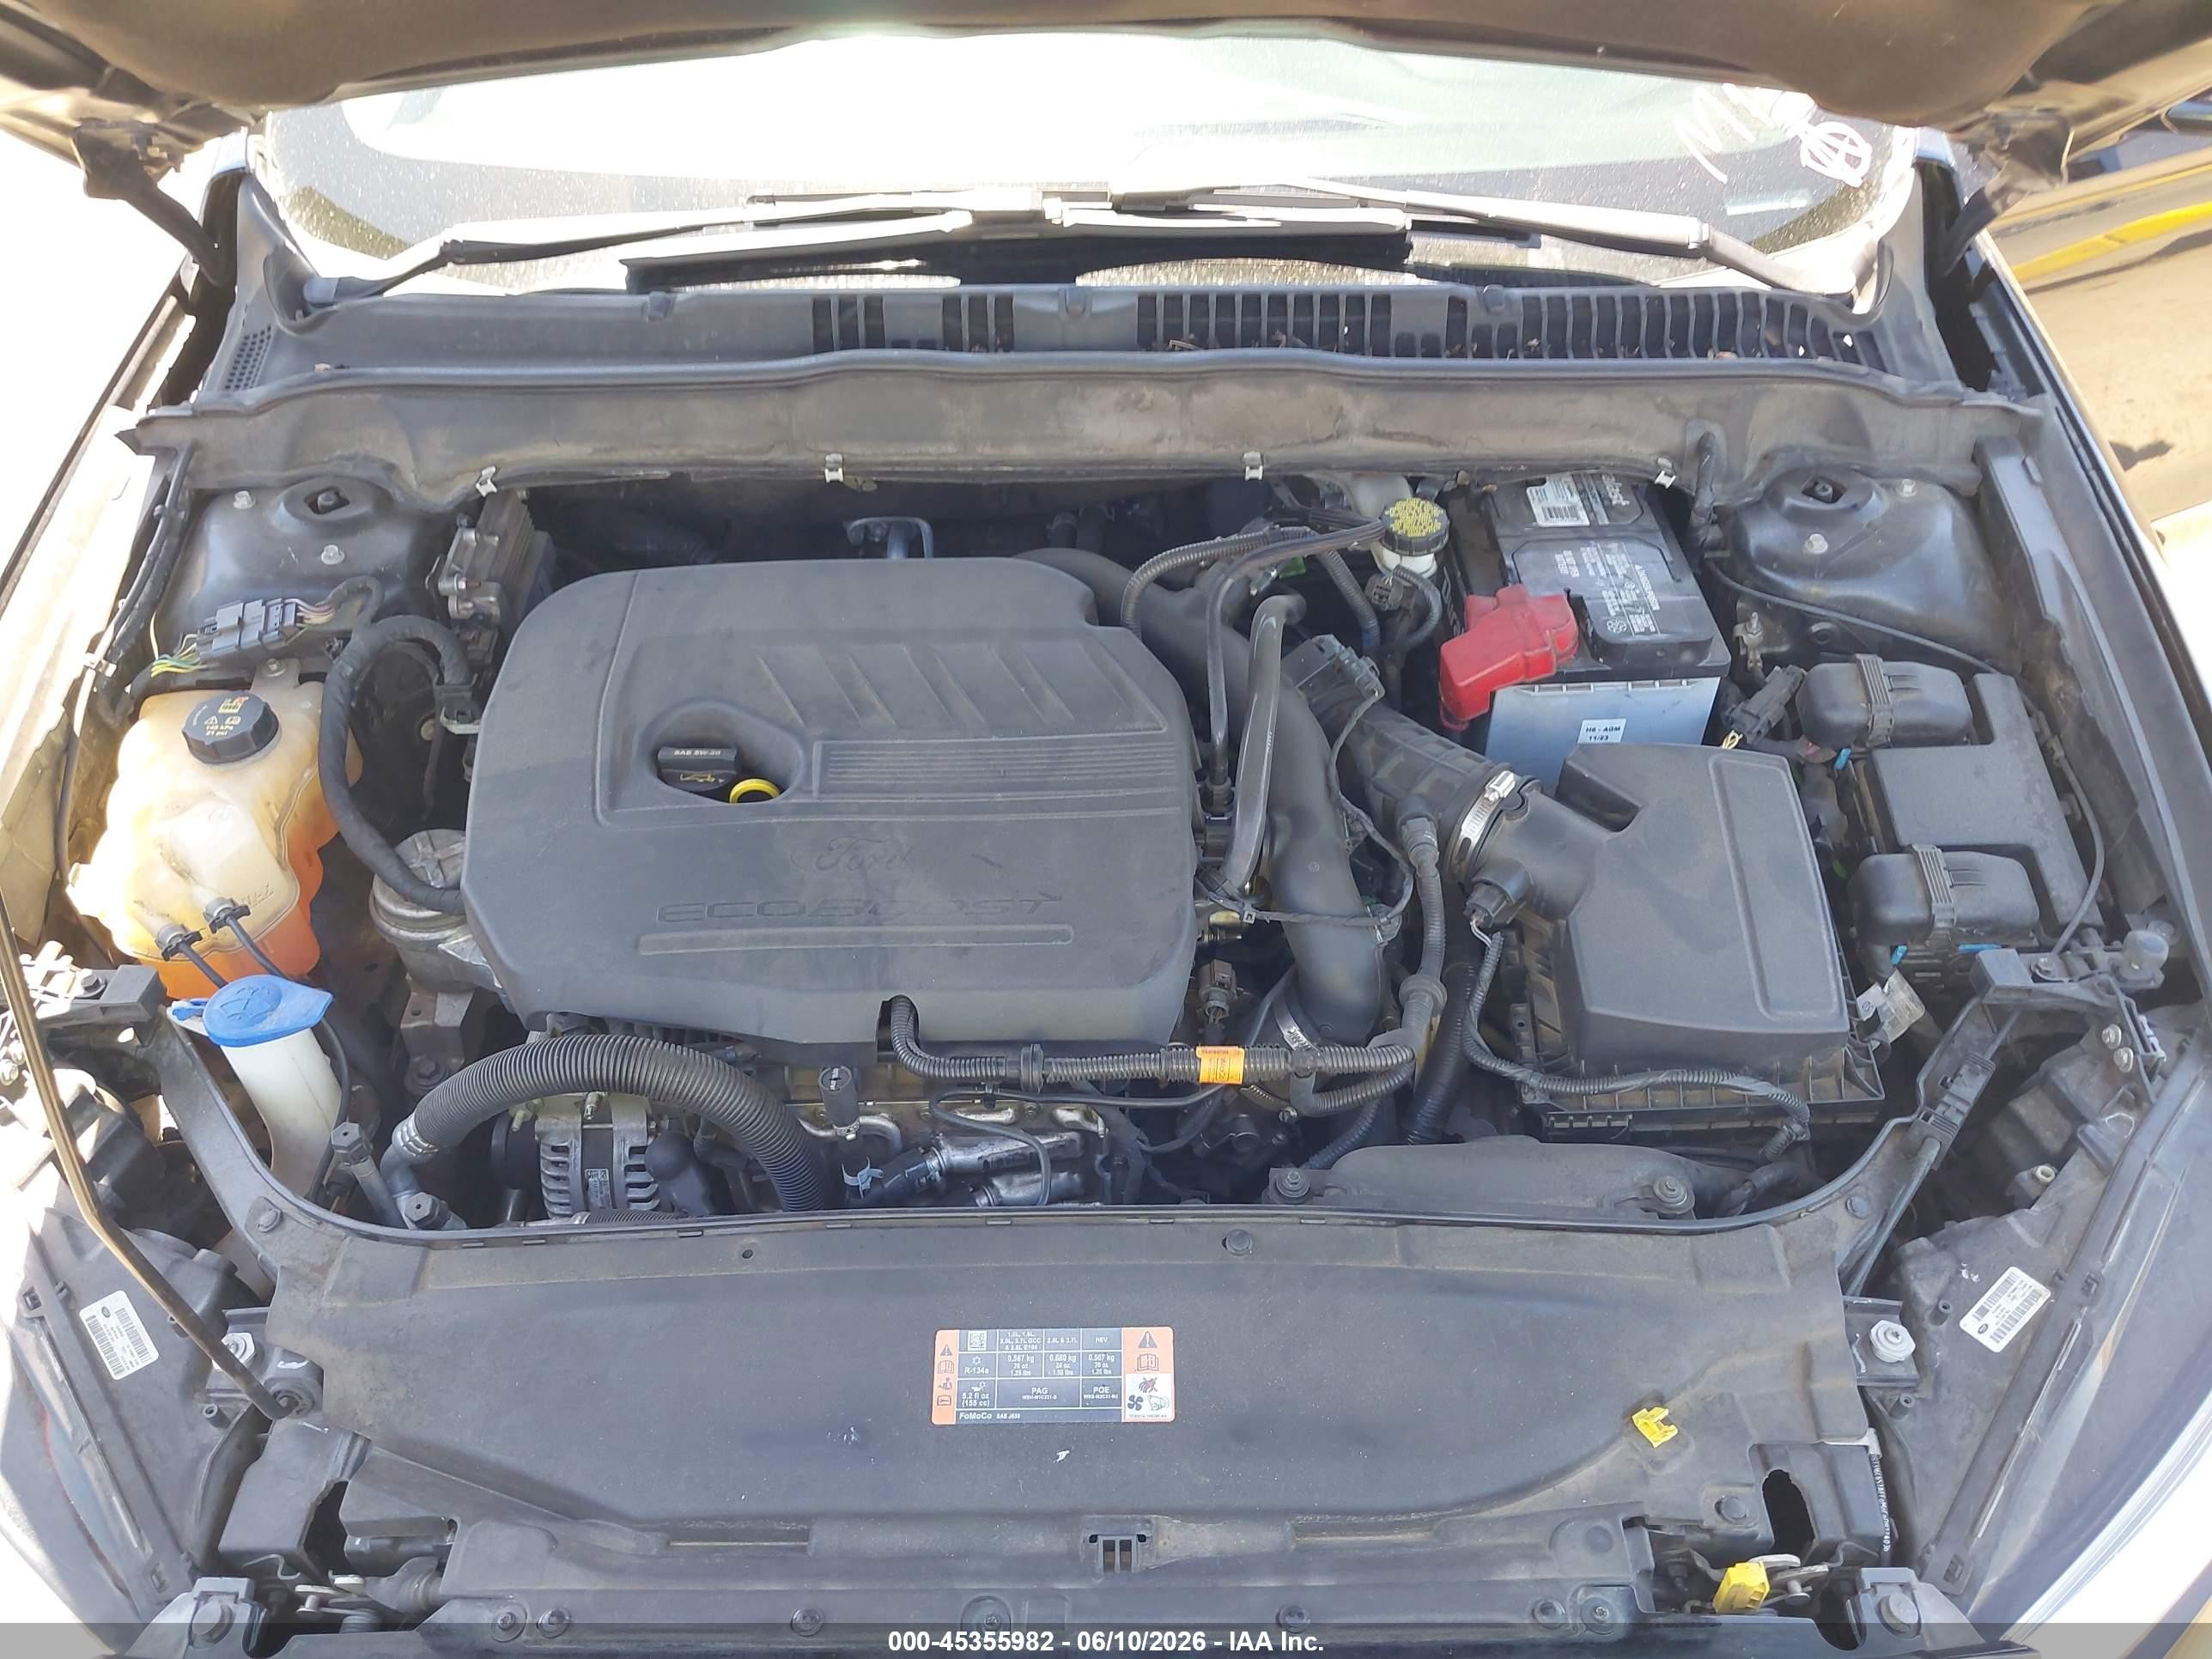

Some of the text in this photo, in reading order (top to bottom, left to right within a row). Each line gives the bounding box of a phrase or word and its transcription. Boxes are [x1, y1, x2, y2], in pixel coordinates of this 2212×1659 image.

[817, 836, 913, 872] Ford
[656, 892, 1062, 922] ECOBOOST
[1026, 1354, 1035, 1364] kg
[1067, 1353, 1077, 1364] kg
[1106, 1353, 1115, 1363] kg
[963, 1365, 989, 1375] R-134a
[962, 1399, 990, 1407] (155 cc)
